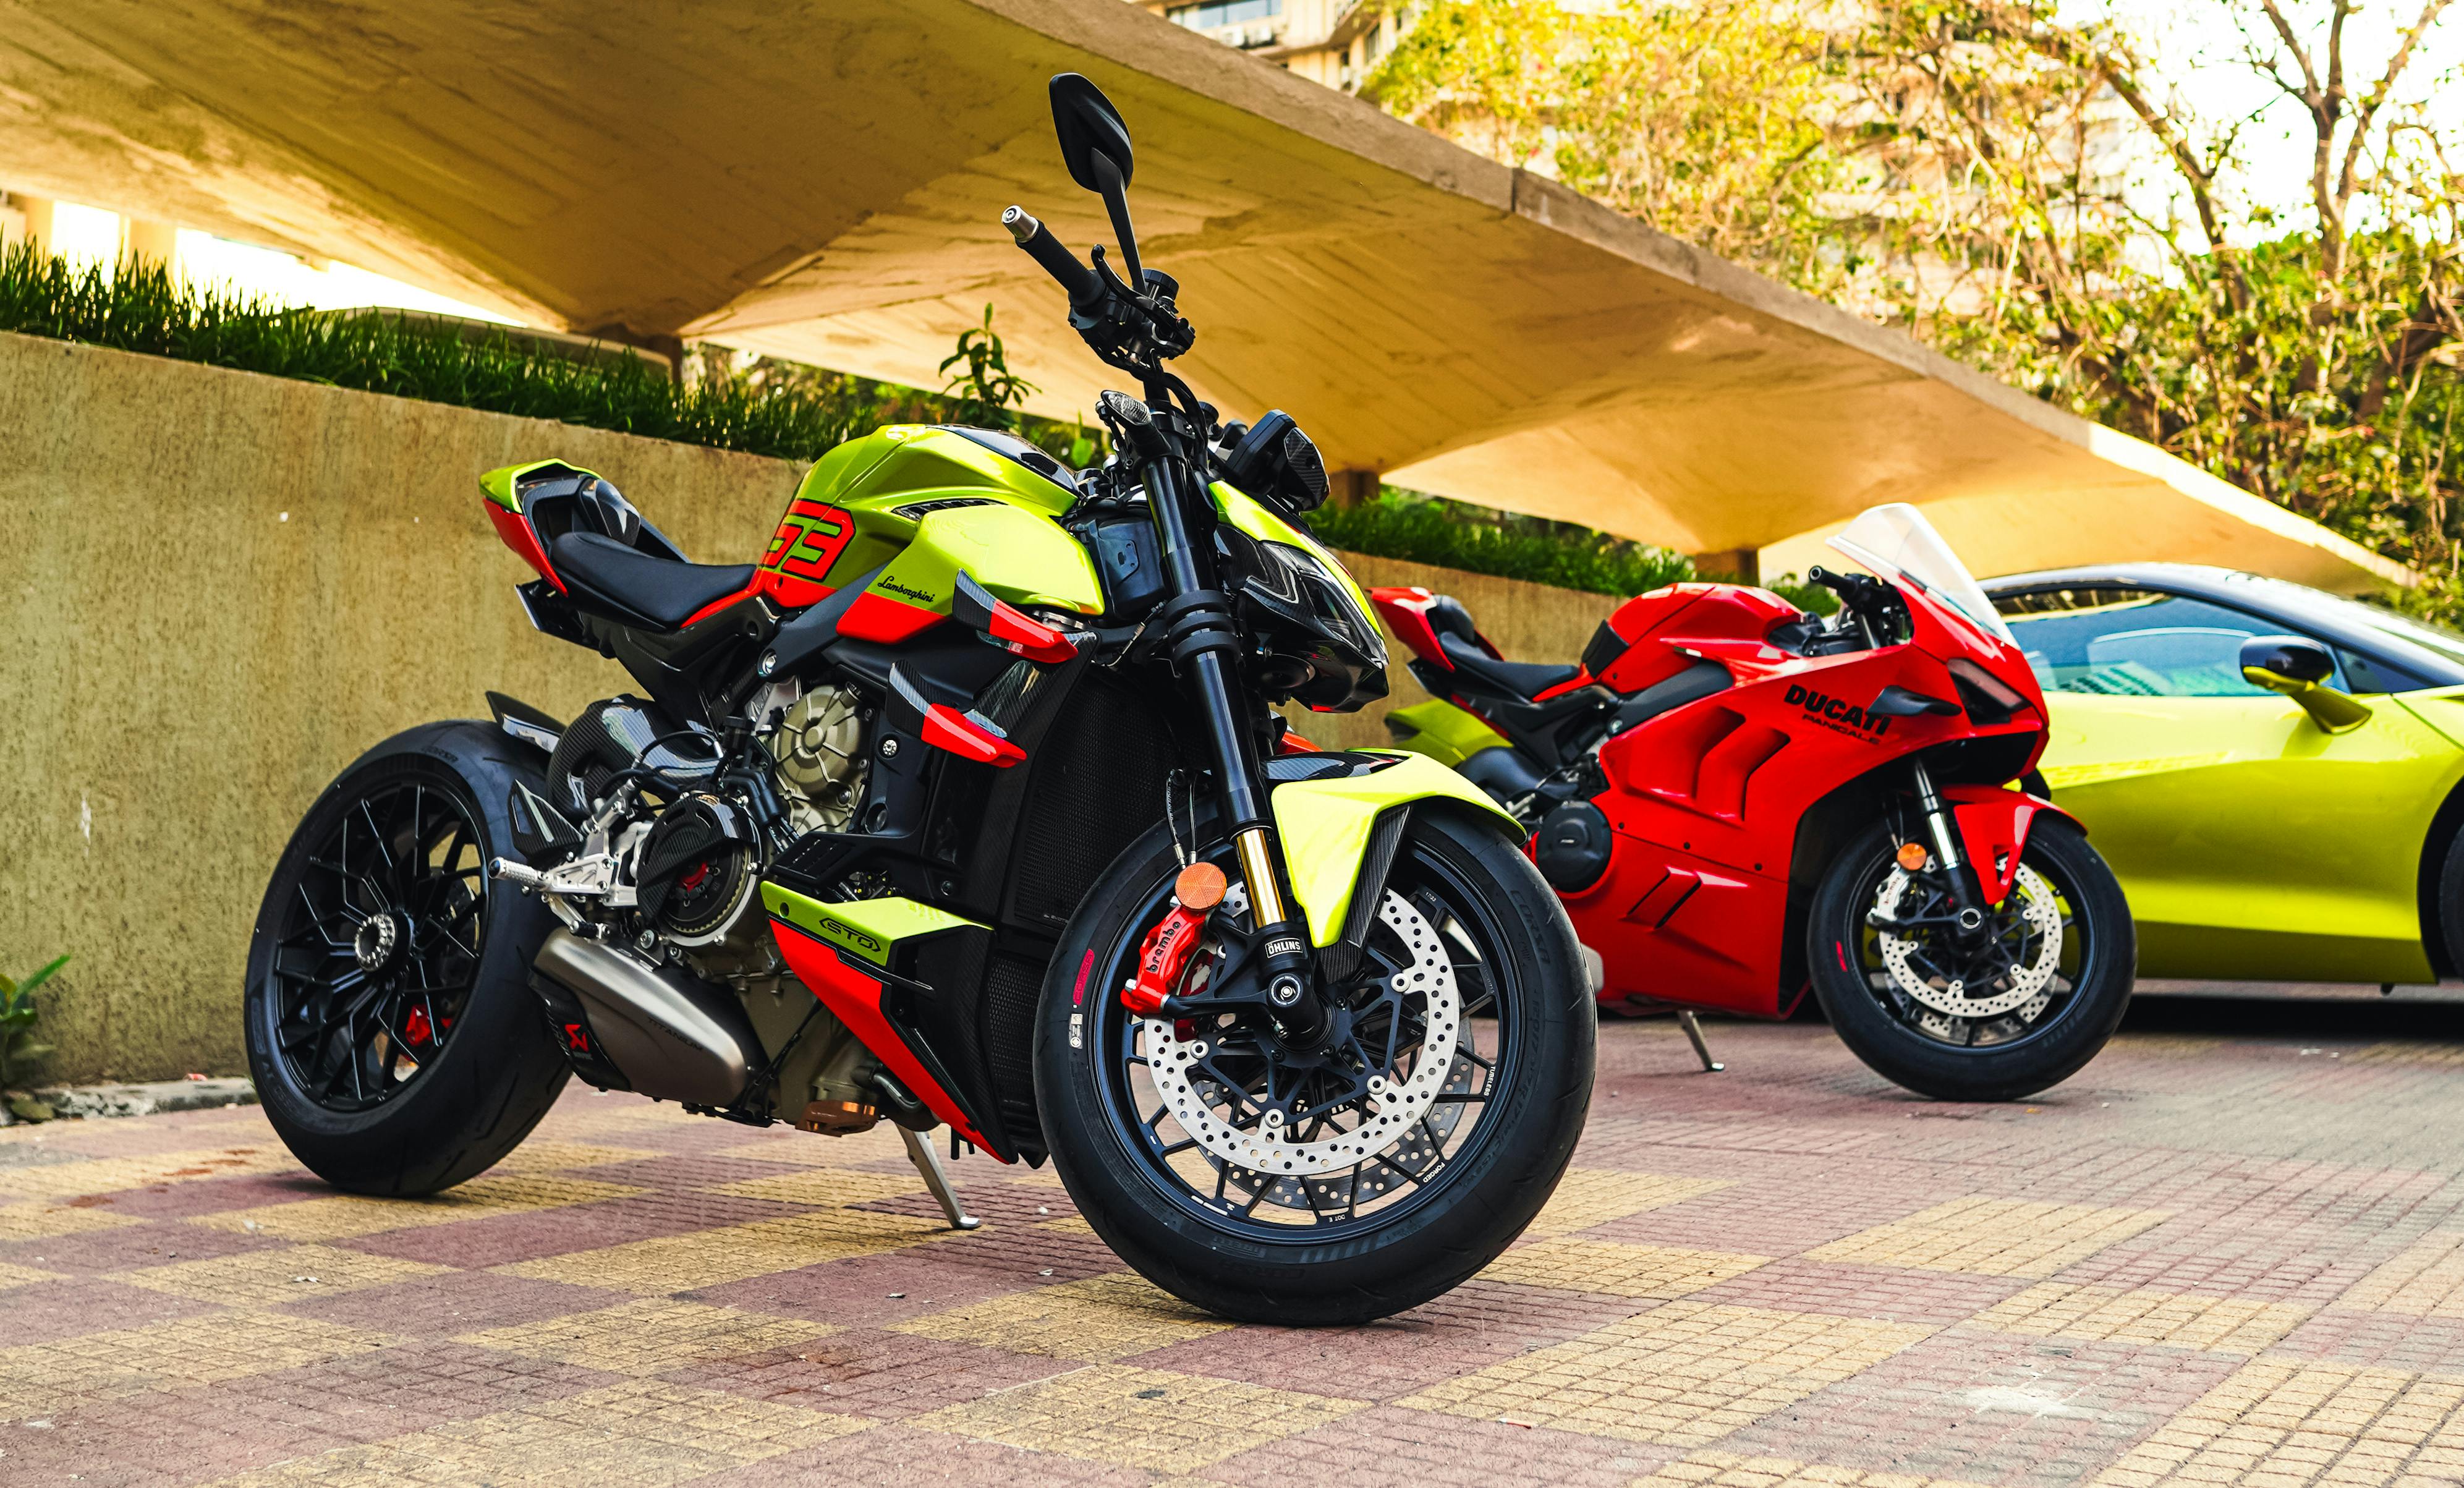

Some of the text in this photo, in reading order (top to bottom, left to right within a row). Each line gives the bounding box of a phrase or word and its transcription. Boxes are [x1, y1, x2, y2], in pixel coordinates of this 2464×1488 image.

[877, 576, 935, 603] Lamborghini
[1784, 684, 1892, 736] DUCATI
[1802, 713, 1881, 746] PANIGALE
[826, 920, 873, 950] STO
[1510, 890, 1550, 964] CORSA
[1145, 920, 1181, 974] brembo
[1268, 939, 1302, 956] ÖHLINS
[647, 1016, 703, 1052] TITANIUM
[1484, 1066, 1496, 1097] TUBELESS
[1422, 1162, 1446, 1184] FORGED
